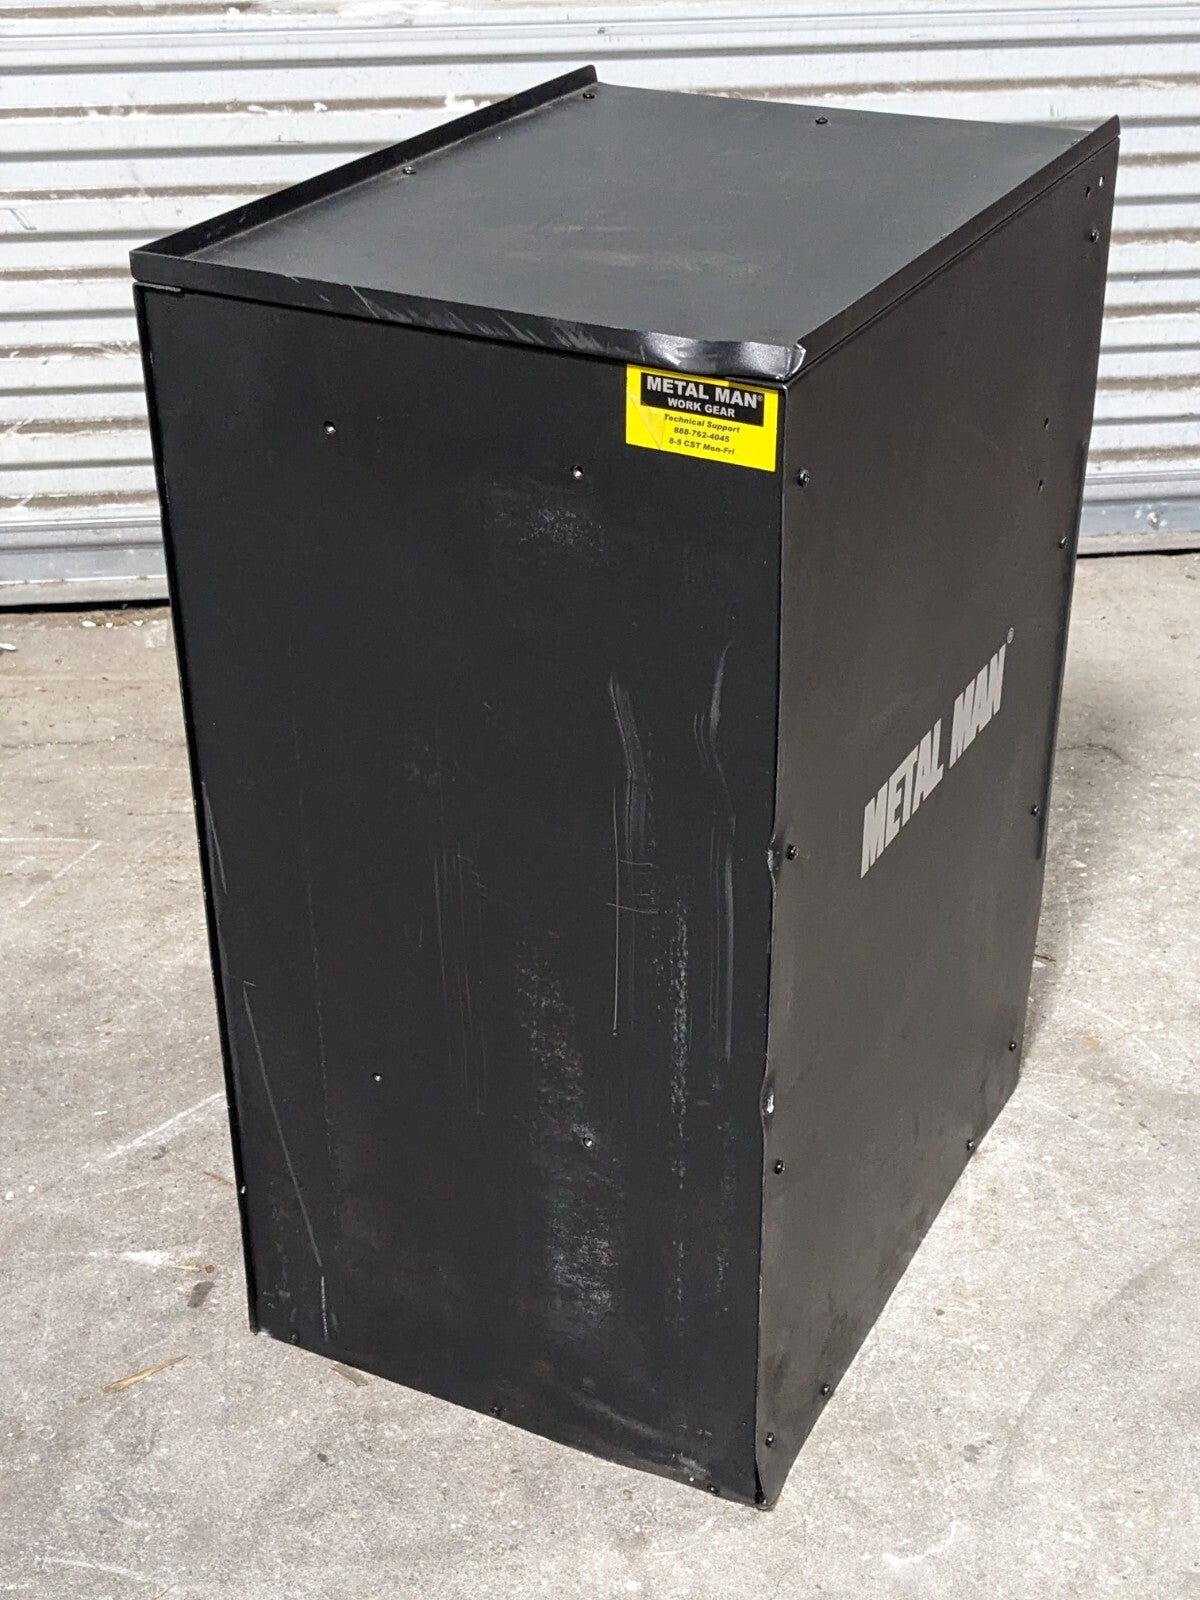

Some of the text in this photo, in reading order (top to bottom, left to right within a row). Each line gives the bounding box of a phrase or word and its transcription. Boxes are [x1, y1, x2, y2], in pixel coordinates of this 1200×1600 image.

[646, 375, 758, 409] METAL MAN
[667, 397, 736, 418] WORK GEAR
[664, 413, 741, 434] Technical Support
[673, 426, 730, 443] 888-762-4045
[668, 437, 736, 455] 8-5 CST Mon-Fri
[860, 643, 1007, 879] METAL MAN
